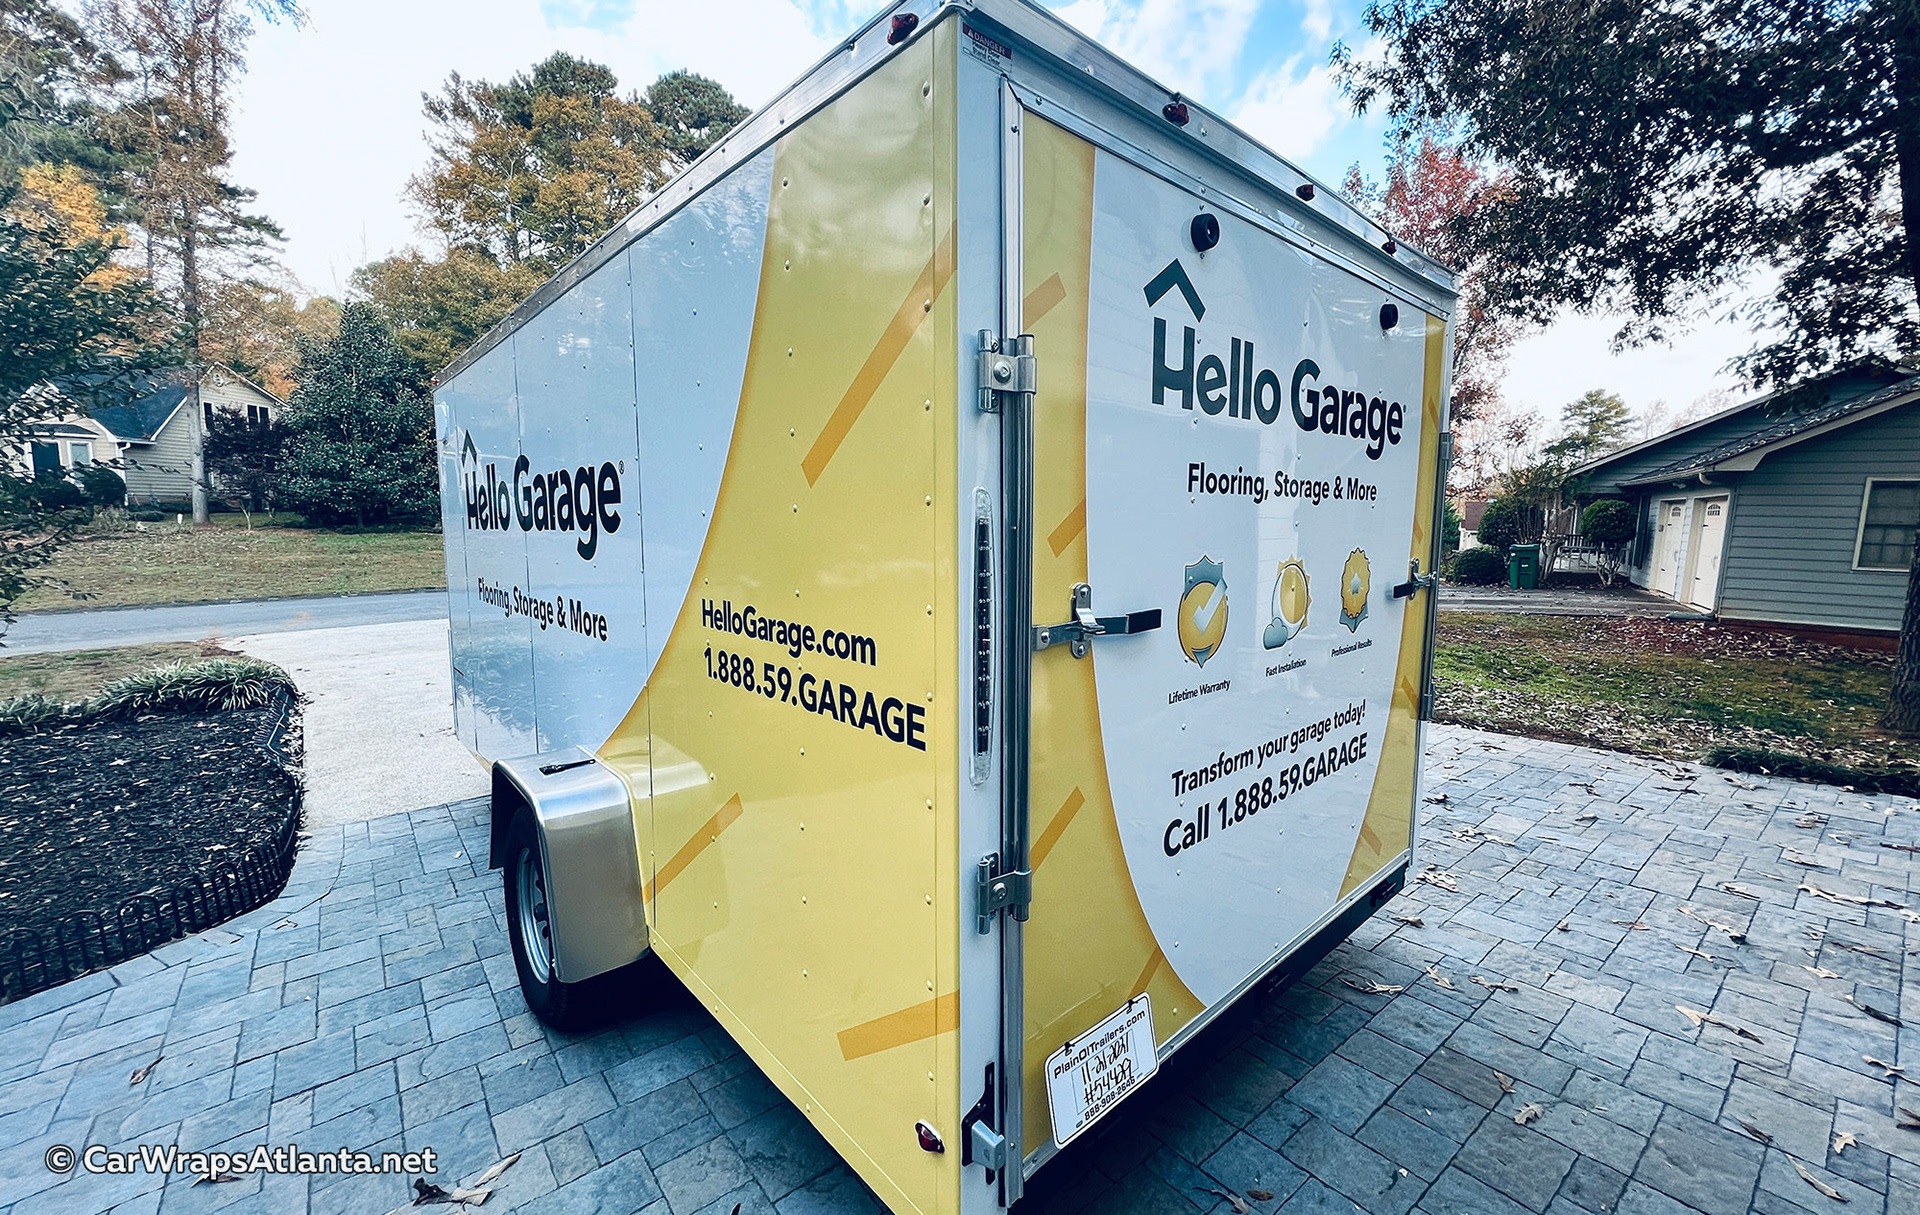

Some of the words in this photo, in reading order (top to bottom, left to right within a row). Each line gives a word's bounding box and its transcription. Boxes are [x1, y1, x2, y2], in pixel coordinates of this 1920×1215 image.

[974, 31, 1005, 55] DANGER
[1152, 317, 1281, 425] Hello
[465, 463, 511, 532] Hello
[1188, 462, 1269, 505] Flooring,
[1274, 471, 1330, 506] Storage
[1333, 476, 1344, 500] &
[1347, 476, 1377, 502] More
[478, 577, 513, 618] Flooring,
[513, 585, 554, 631] Storage
[556, 595, 567, 628] &
[569, 598, 608, 642] More
[701, 598, 877, 667] HelloGarage.com
[1265, 666, 1278, 677] Fast
[1278, 658, 1307, 674] Installation
[1330, 642, 1357, 658] Professional
[703, 647, 927, 752] 1.888.59.GARAGE
[1168, 687, 1198, 705] Lifetime
[1199, 679, 1231, 697] Warranty
[1172, 748, 1254, 798] Transform
[1257, 735, 1289, 769] your
[1290, 718, 1331, 750] garage
[1333, 699, 1366, 728] today!
[1163, 802, 1210, 857] Call
[1217, 732, 1368, 831] 1.888.59.GARAGE
